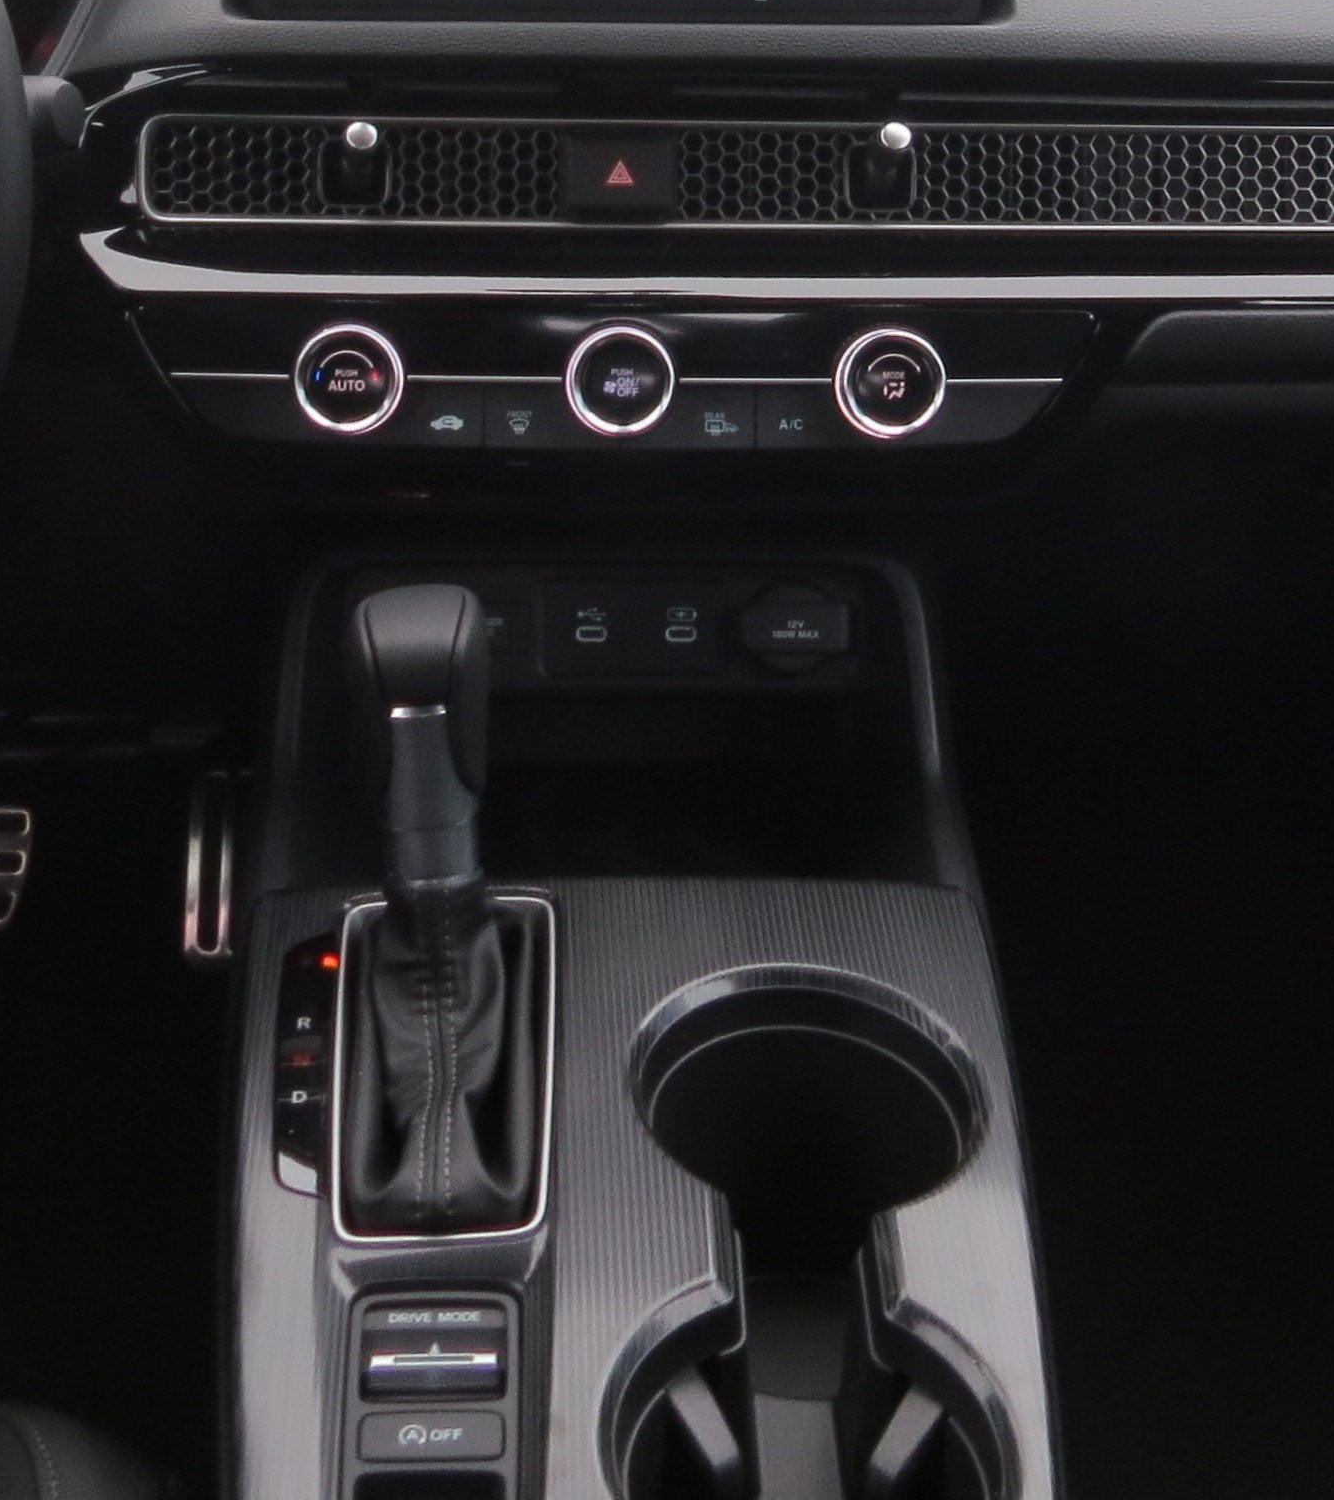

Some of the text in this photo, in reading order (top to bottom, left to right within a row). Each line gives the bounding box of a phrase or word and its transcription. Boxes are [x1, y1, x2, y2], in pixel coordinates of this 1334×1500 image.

[334, 368, 359, 377] PUSH
[610, 368, 634, 377] PUSH
[881, 371, 906, 380] MODE
[328, 379, 366, 392] AUTO
[616, 387, 639, 398] OFF
[778, 418, 804, 432] A/C
[797, 630, 820, 639] MAX
[295, 1016, 312, 1030] R
[291, 1089, 308, 1104] D
[387, 1311, 481, 1324] DRIVE MODE
[430, 1428, 464, 1441] OFF
